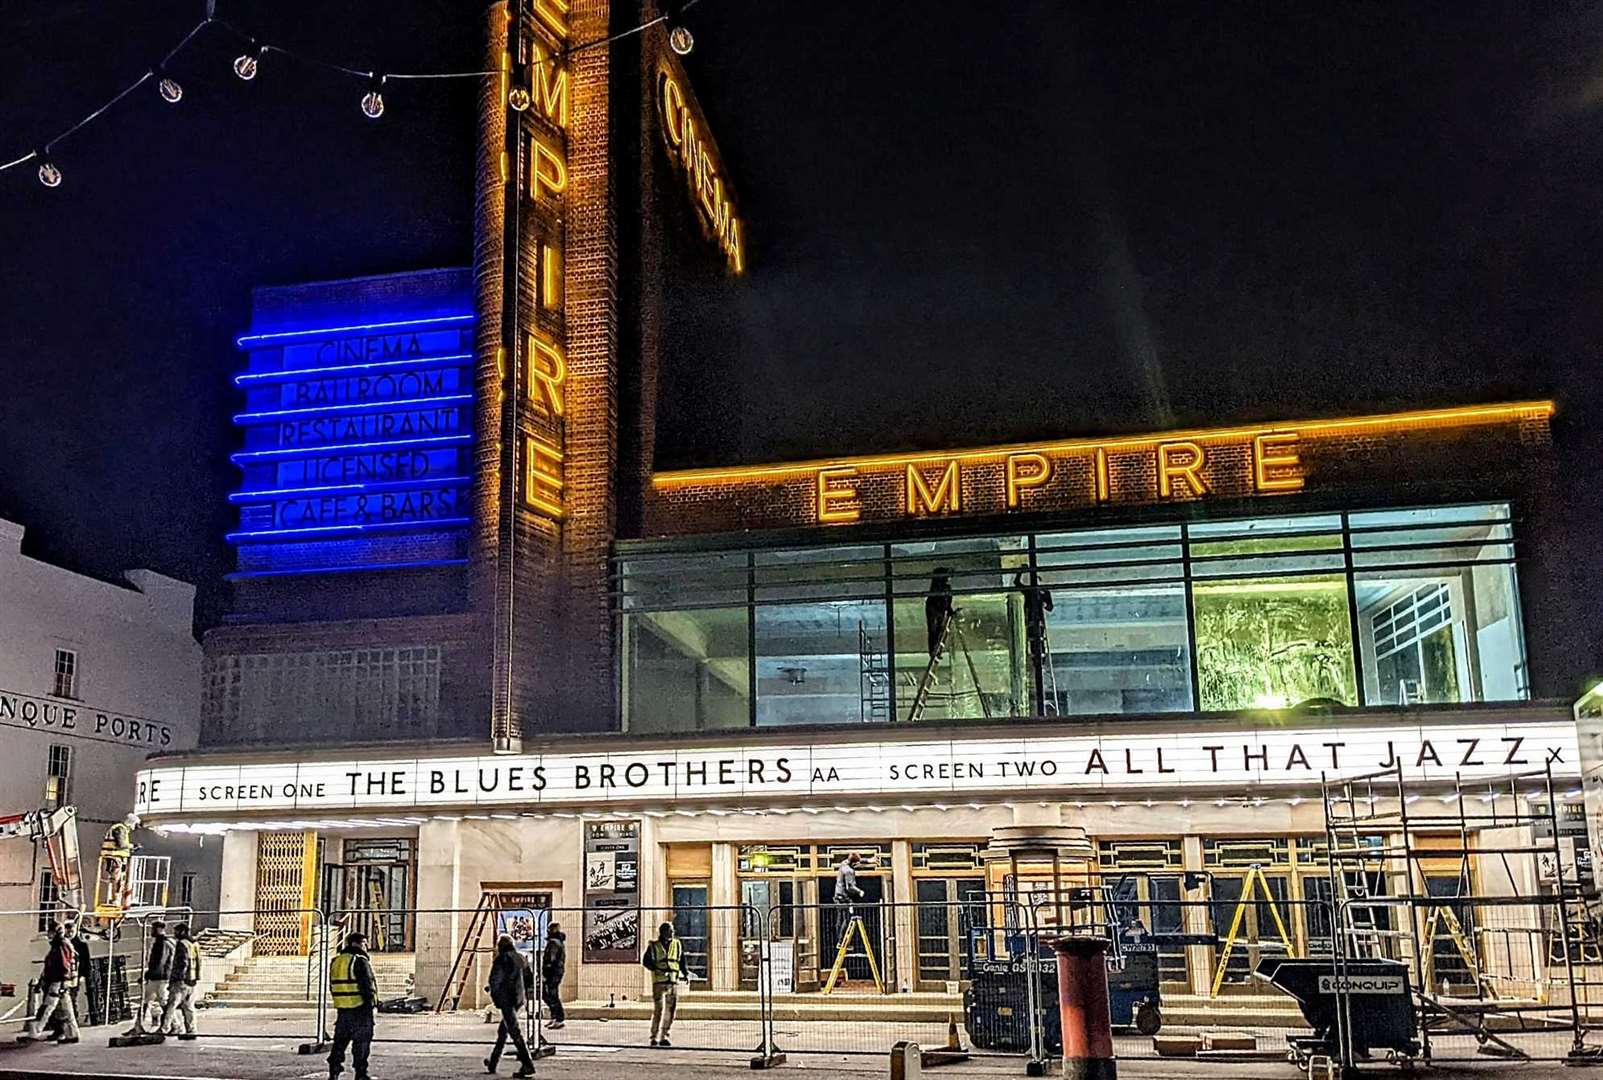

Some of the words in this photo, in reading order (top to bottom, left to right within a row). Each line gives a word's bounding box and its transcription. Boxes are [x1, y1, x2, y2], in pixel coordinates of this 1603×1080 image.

[663, 77, 742, 273] CINEMA
[316, 335, 422, 365] CINEMA
[296, 367, 444, 405] BALLROOM
[281, 410, 455, 445] RESTAURANT
[303, 451, 430, 482] LICENSED
[817, 432, 1305, 523] EMPIRE
[354, 495, 371, 520] &
[381, 487, 453, 519] BARS
[95, 714, 172, 746] PORTS
[199, 784, 273, 800] SCREEN
[282, 783, 326, 798] ONE
[346, 771, 406, 796] THE
[430, 766, 547, 794] BLUES
[575, 757, 793, 790] BROTHERS
[811, 767, 841, 783] AA
[889, 762, 984, 780] SCREEN
[997, 760, 1058, 777] TWO
[1084, 747, 1176, 775] ALL
[1202, 742, 1347, 772] THAT
[1378, 736, 1529, 769] JAZZ
[983, 962, 1009, 972] Genie
[1331, 980, 1400, 991] CONQUIP
